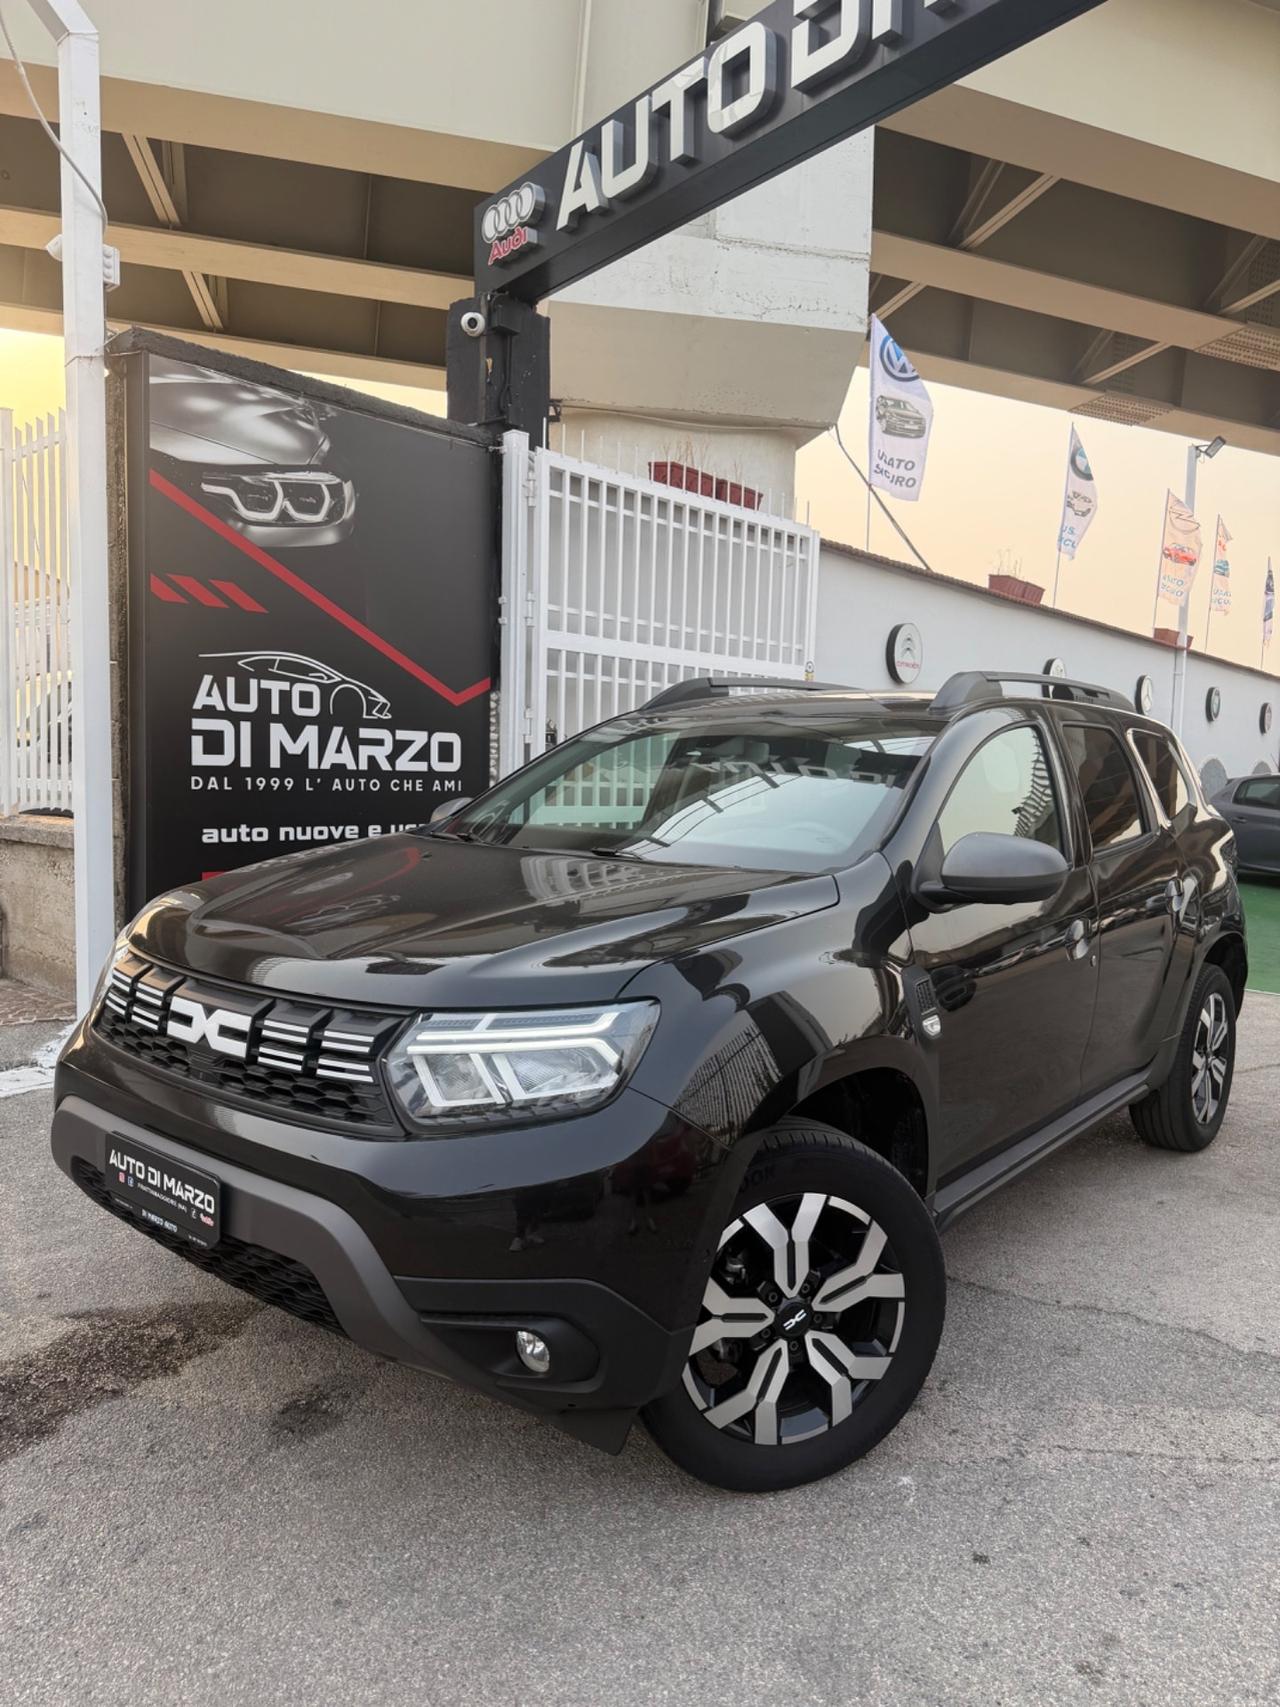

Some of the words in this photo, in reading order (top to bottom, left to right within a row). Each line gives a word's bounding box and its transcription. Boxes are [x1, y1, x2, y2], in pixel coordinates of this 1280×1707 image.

[555, 21, 776, 231] AUTO
[488, 226, 529, 266] Audi
[192, 674, 321, 717] AUTO
[191, 718, 252, 768] DI
[269, 723, 462, 773] MARZO
[191, 776, 233, 790] DAL
[245, 777, 294, 791] 1999
[332, 779, 380, 792] AUTO
[390, 779, 423, 792] CHE
[432, 780, 462, 792] AMI
[202, 823, 269, 844] auto
[279, 825, 359, 842] nuove
[367, 824, 382, 839] e
[109, 1149, 145, 1180] AUTO
[147, 1166, 161, 1188] DI
[163, 1174, 215, 1214] MARZO
